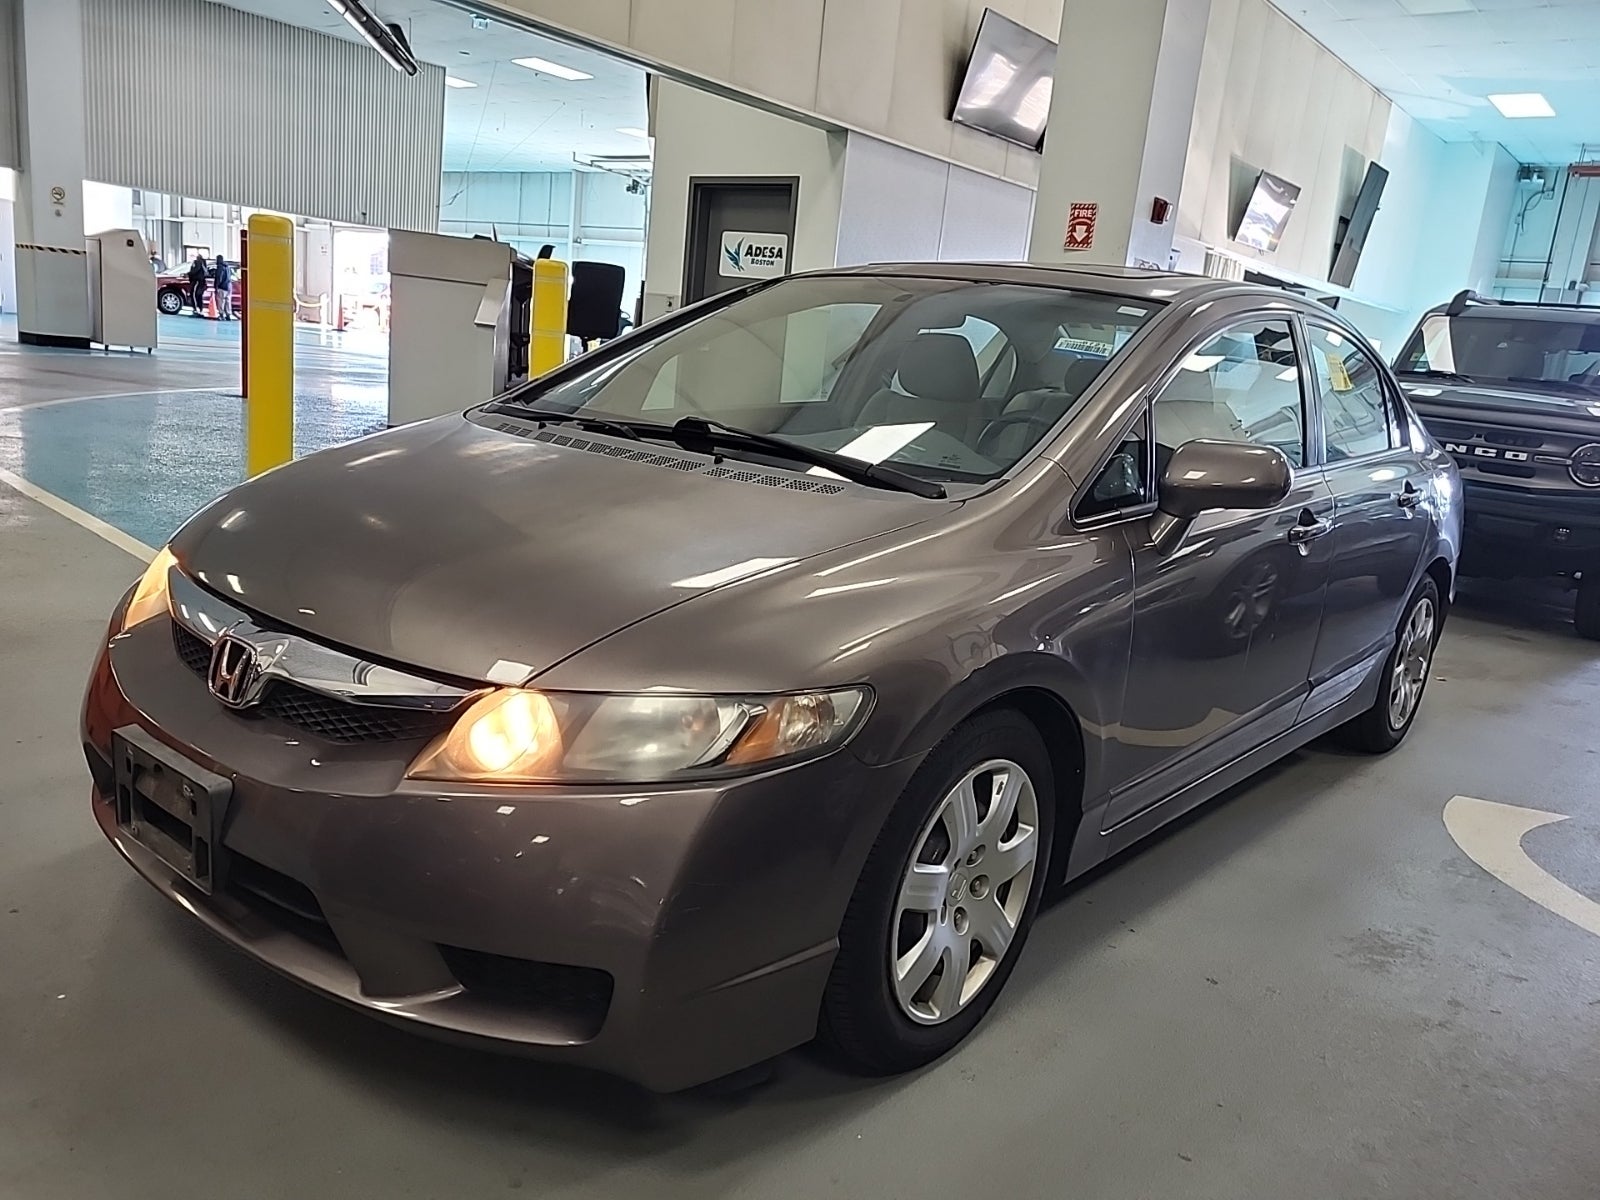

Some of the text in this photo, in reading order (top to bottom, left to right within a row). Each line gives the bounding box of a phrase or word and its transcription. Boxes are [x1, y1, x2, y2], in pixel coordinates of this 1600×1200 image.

[1074, 209, 1093, 218] FIRE
[744, 244, 783, 259] ADESA
[750, 258, 775, 266] BOSTON
[1445, 443, 1528, 461] NCO
